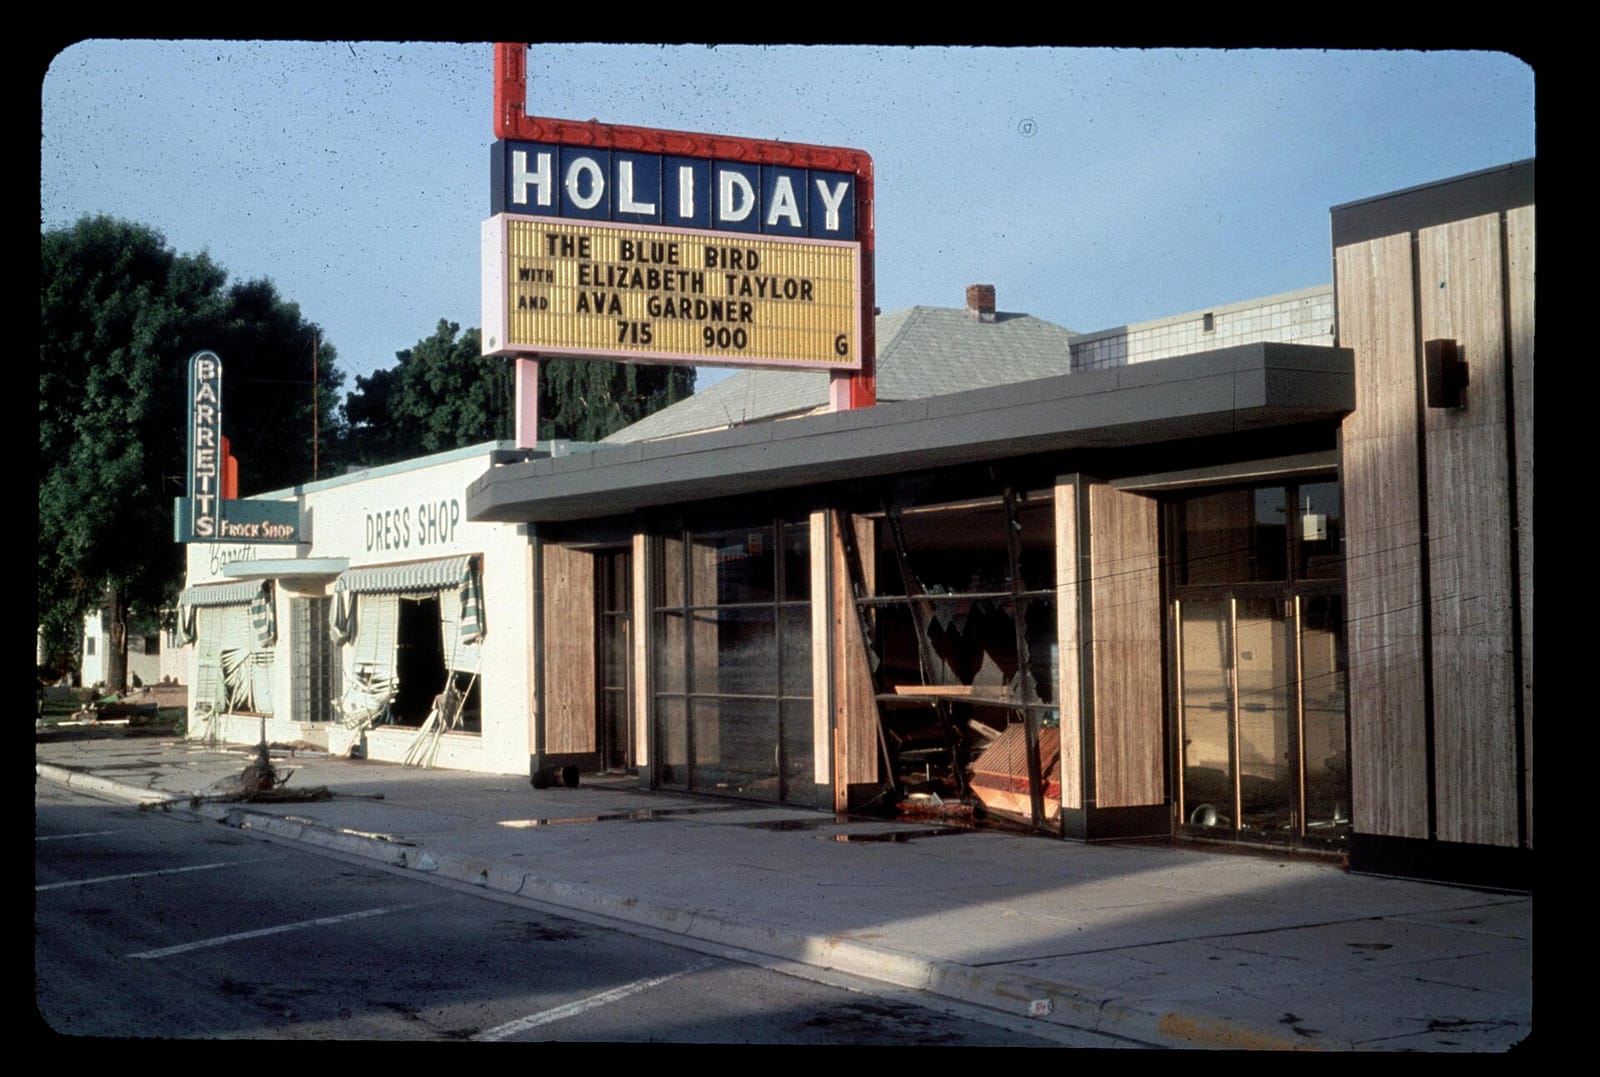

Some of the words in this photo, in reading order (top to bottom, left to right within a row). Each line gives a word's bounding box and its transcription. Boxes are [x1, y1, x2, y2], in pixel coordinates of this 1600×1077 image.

[513, 150, 850, 231] HOLIDAY
[546, 234, 591, 259] THE
[620, 239, 680, 264] BLUE
[704, 246, 760, 271] BIRD
[519, 268, 554, 283] WITH
[578, 264, 704, 294] ELIZABETH
[725, 274, 813, 301] TAYLOR
[518, 295, 549, 310] AND
[576, 291, 623, 316] AVA
[647, 296, 753, 323] GARDNER
[617, 321, 653, 344] 715
[703, 326, 747, 349] 900
[834, 333, 849, 356] G
[196, 359, 217, 537] BARRETTS
[221, 519, 259, 537] FROCK
[261, 520, 294, 538] SHOP
[366, 506, 410, 552] DRESS
[418, 498, 460, 546] SHOP
